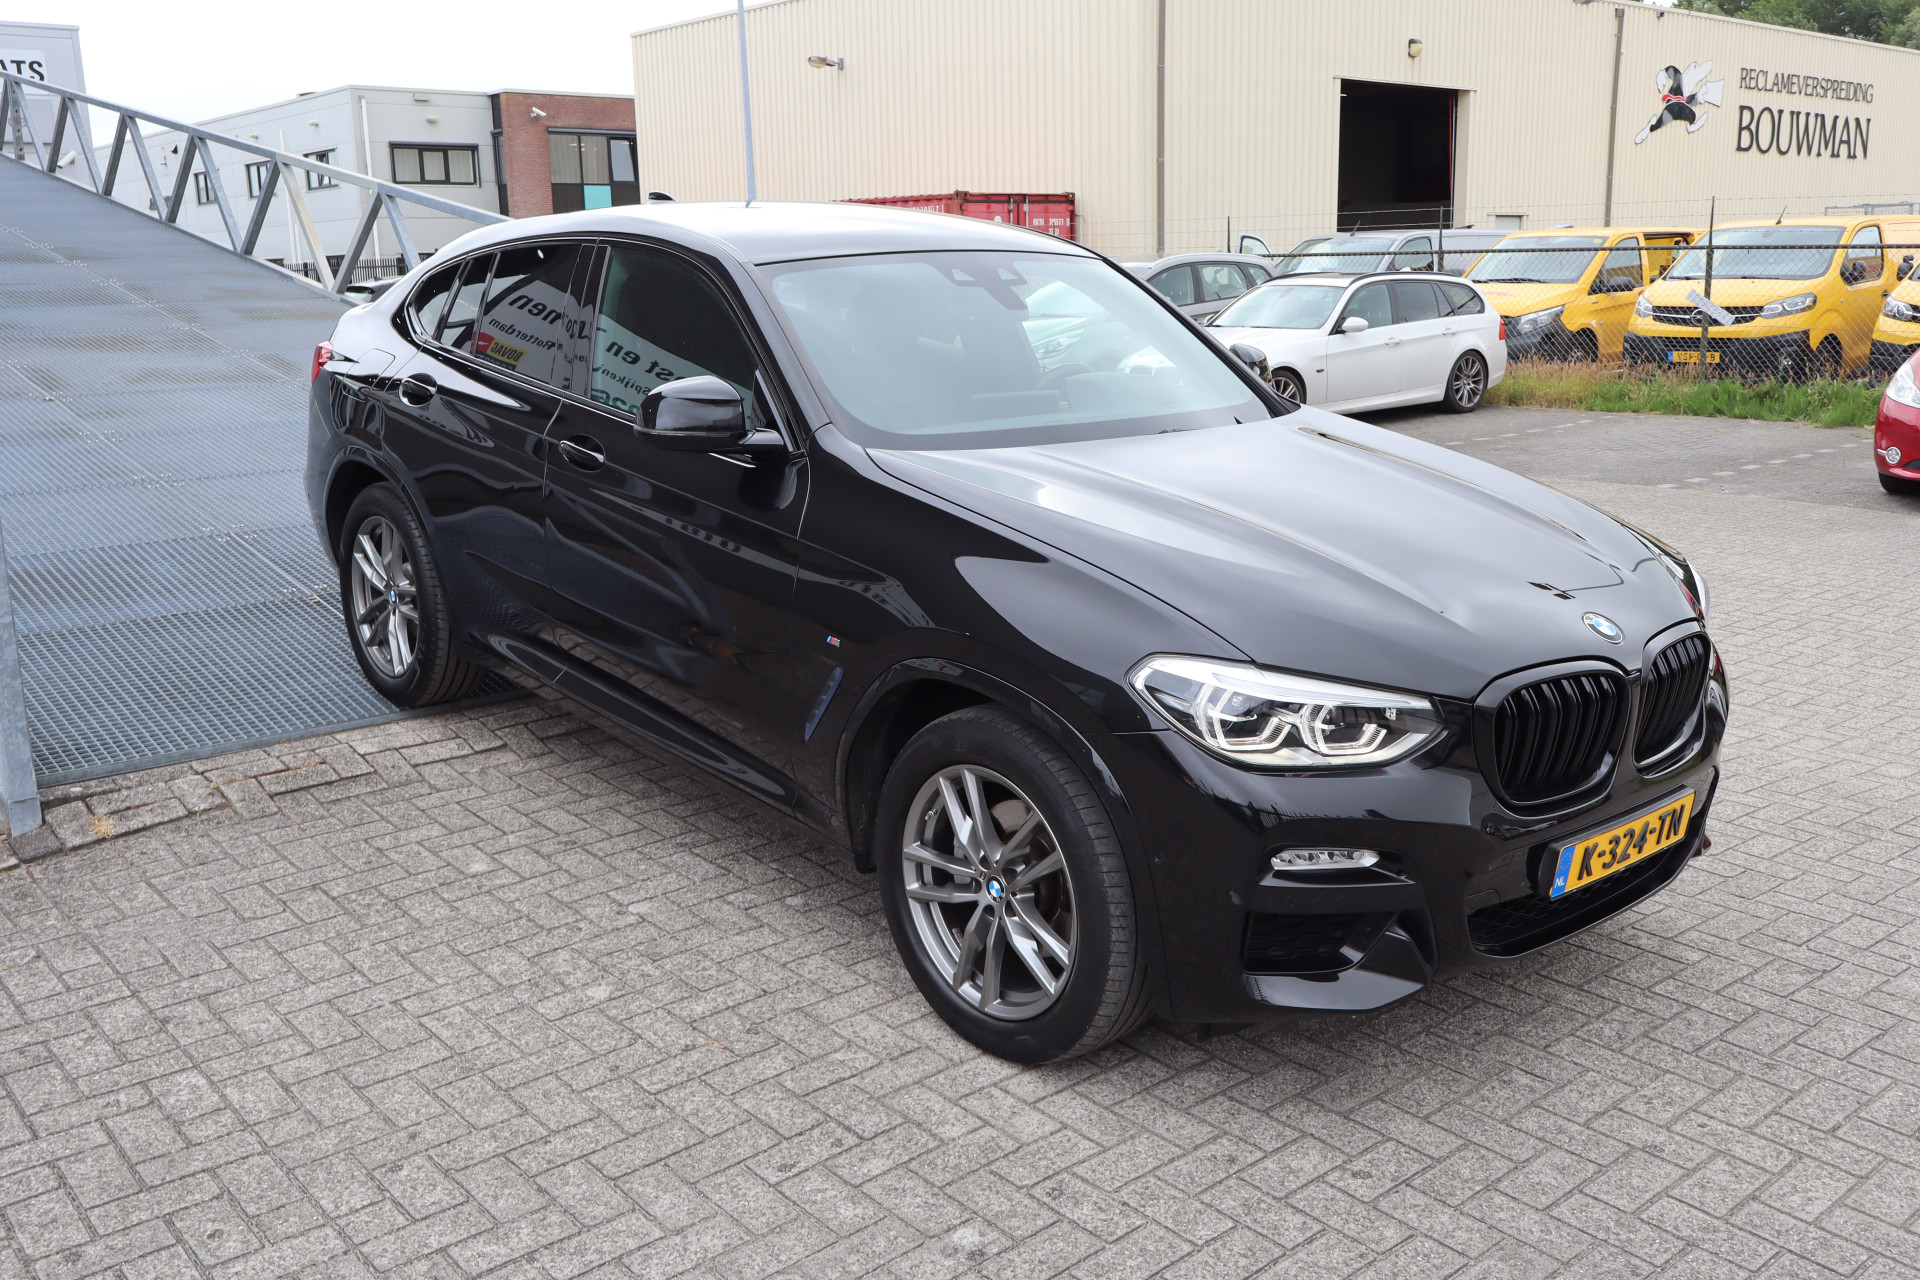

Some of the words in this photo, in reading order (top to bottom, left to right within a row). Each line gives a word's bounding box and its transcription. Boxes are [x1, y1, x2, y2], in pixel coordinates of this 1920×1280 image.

[1739, 67, 1874, 103] RECLAMEVERSPREIDING
[1736, 105, 1871, 159] BOUWMAN
[1554, 875, 1565, 887] NL
[1577, 803, 1686, 881] K-324-TN
